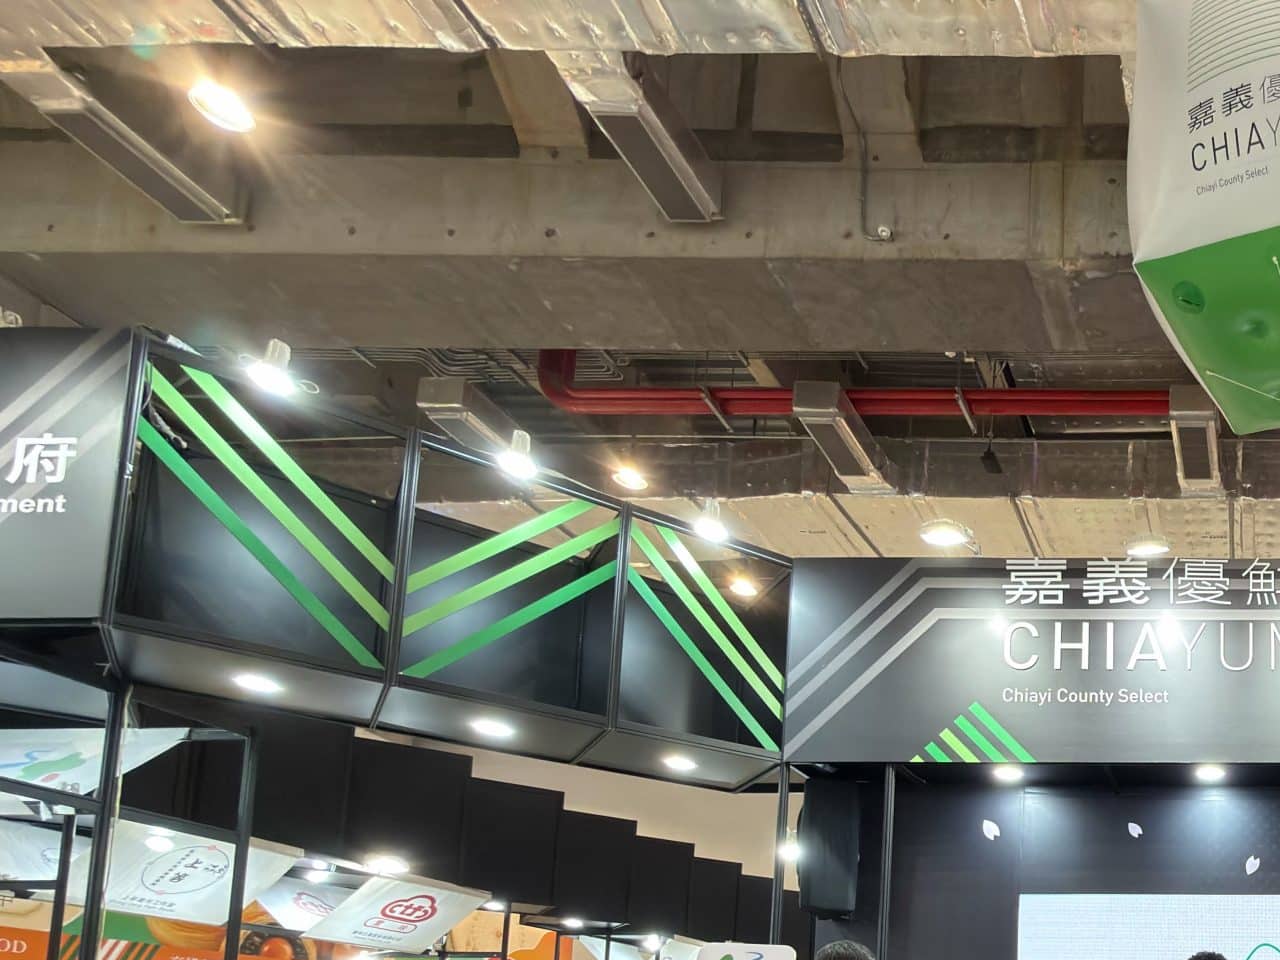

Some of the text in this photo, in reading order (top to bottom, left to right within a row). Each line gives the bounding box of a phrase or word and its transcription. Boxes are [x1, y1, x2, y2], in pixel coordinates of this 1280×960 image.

[1196, 165, 1270, 196] Chiayi County Select
[5, 432, 77, 484] 府
[0, 494, 66, 514] ment
[1001, 687, 1169, 707] Chiayi County Select
